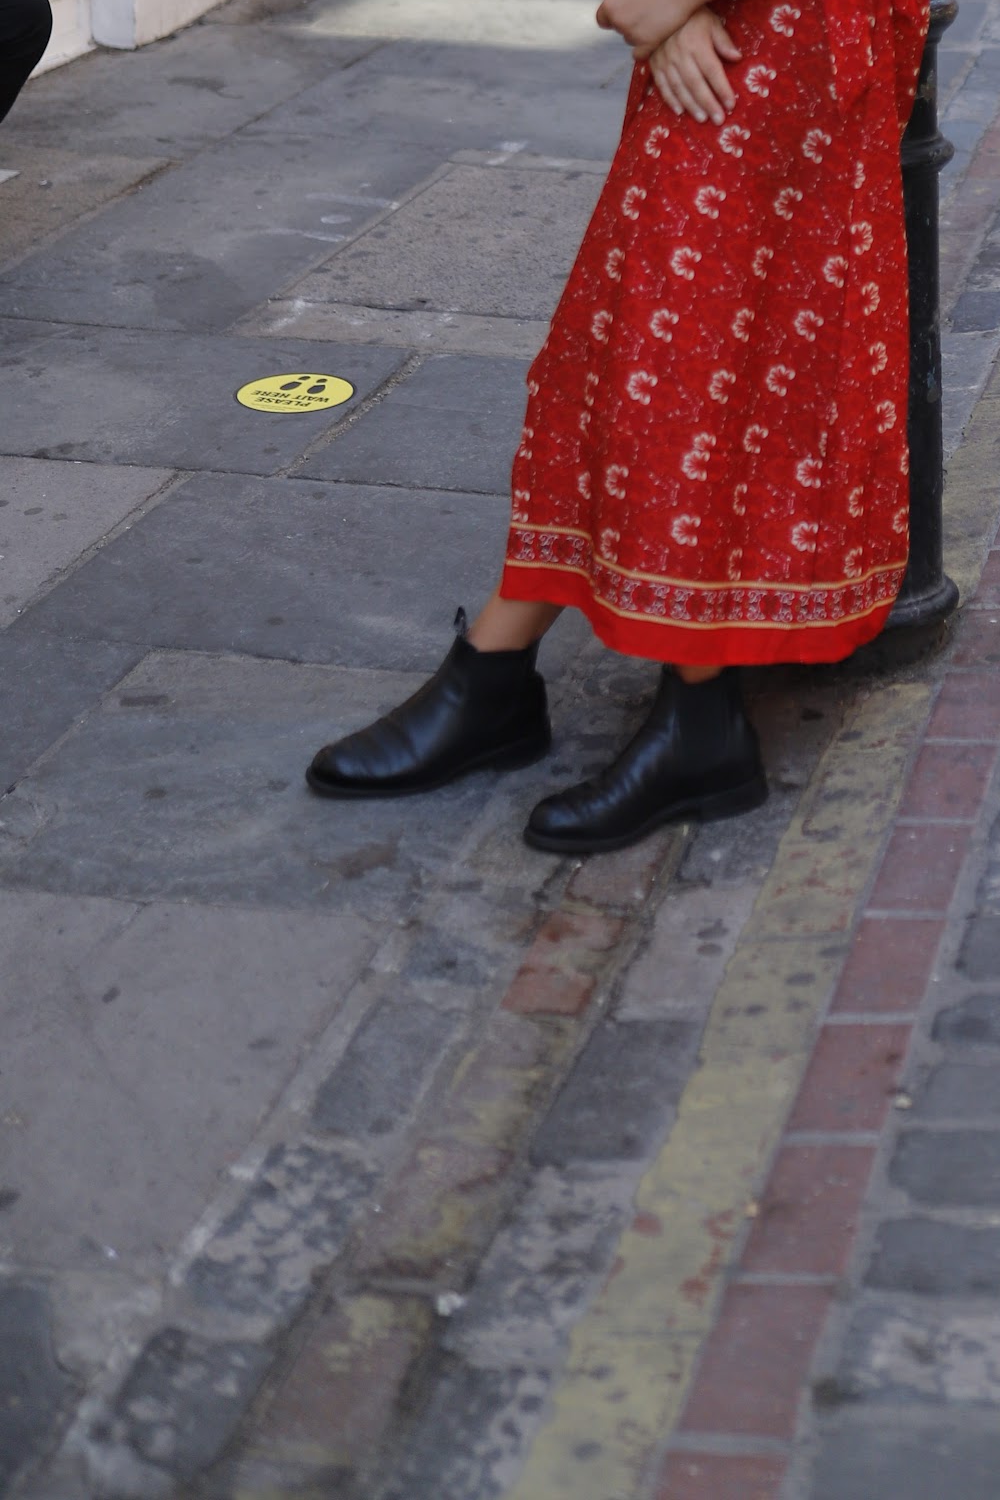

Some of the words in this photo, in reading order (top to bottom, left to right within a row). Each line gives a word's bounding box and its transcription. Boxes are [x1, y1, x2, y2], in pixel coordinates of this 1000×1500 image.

[250, 389, 292, 400] HERE
[293, 394, 330, 403] WAIT
[254, 396, 312, 408] PLEASE
